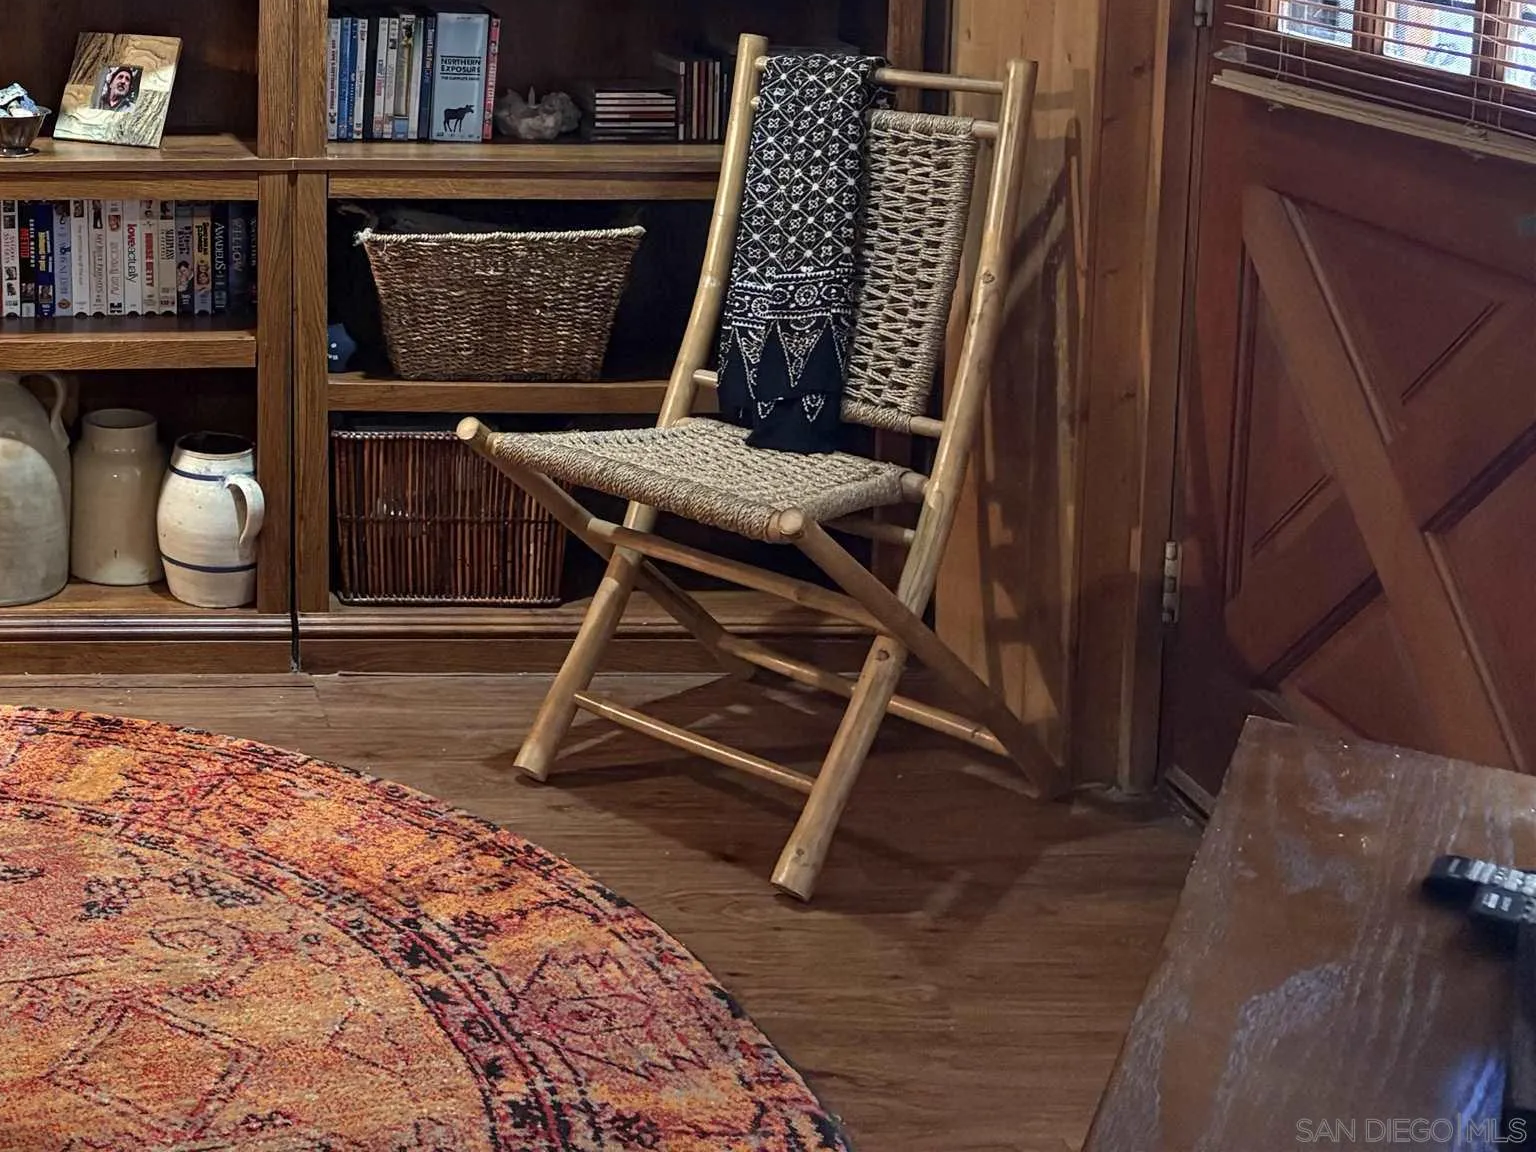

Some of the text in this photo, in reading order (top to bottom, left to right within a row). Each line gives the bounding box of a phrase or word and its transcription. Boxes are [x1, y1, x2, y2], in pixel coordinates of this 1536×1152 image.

[440, 65, 481, 73] EXPOSURE
[214, 222, 227, 271] AMADEUS
[145, 261, 154, 287] BETTY
